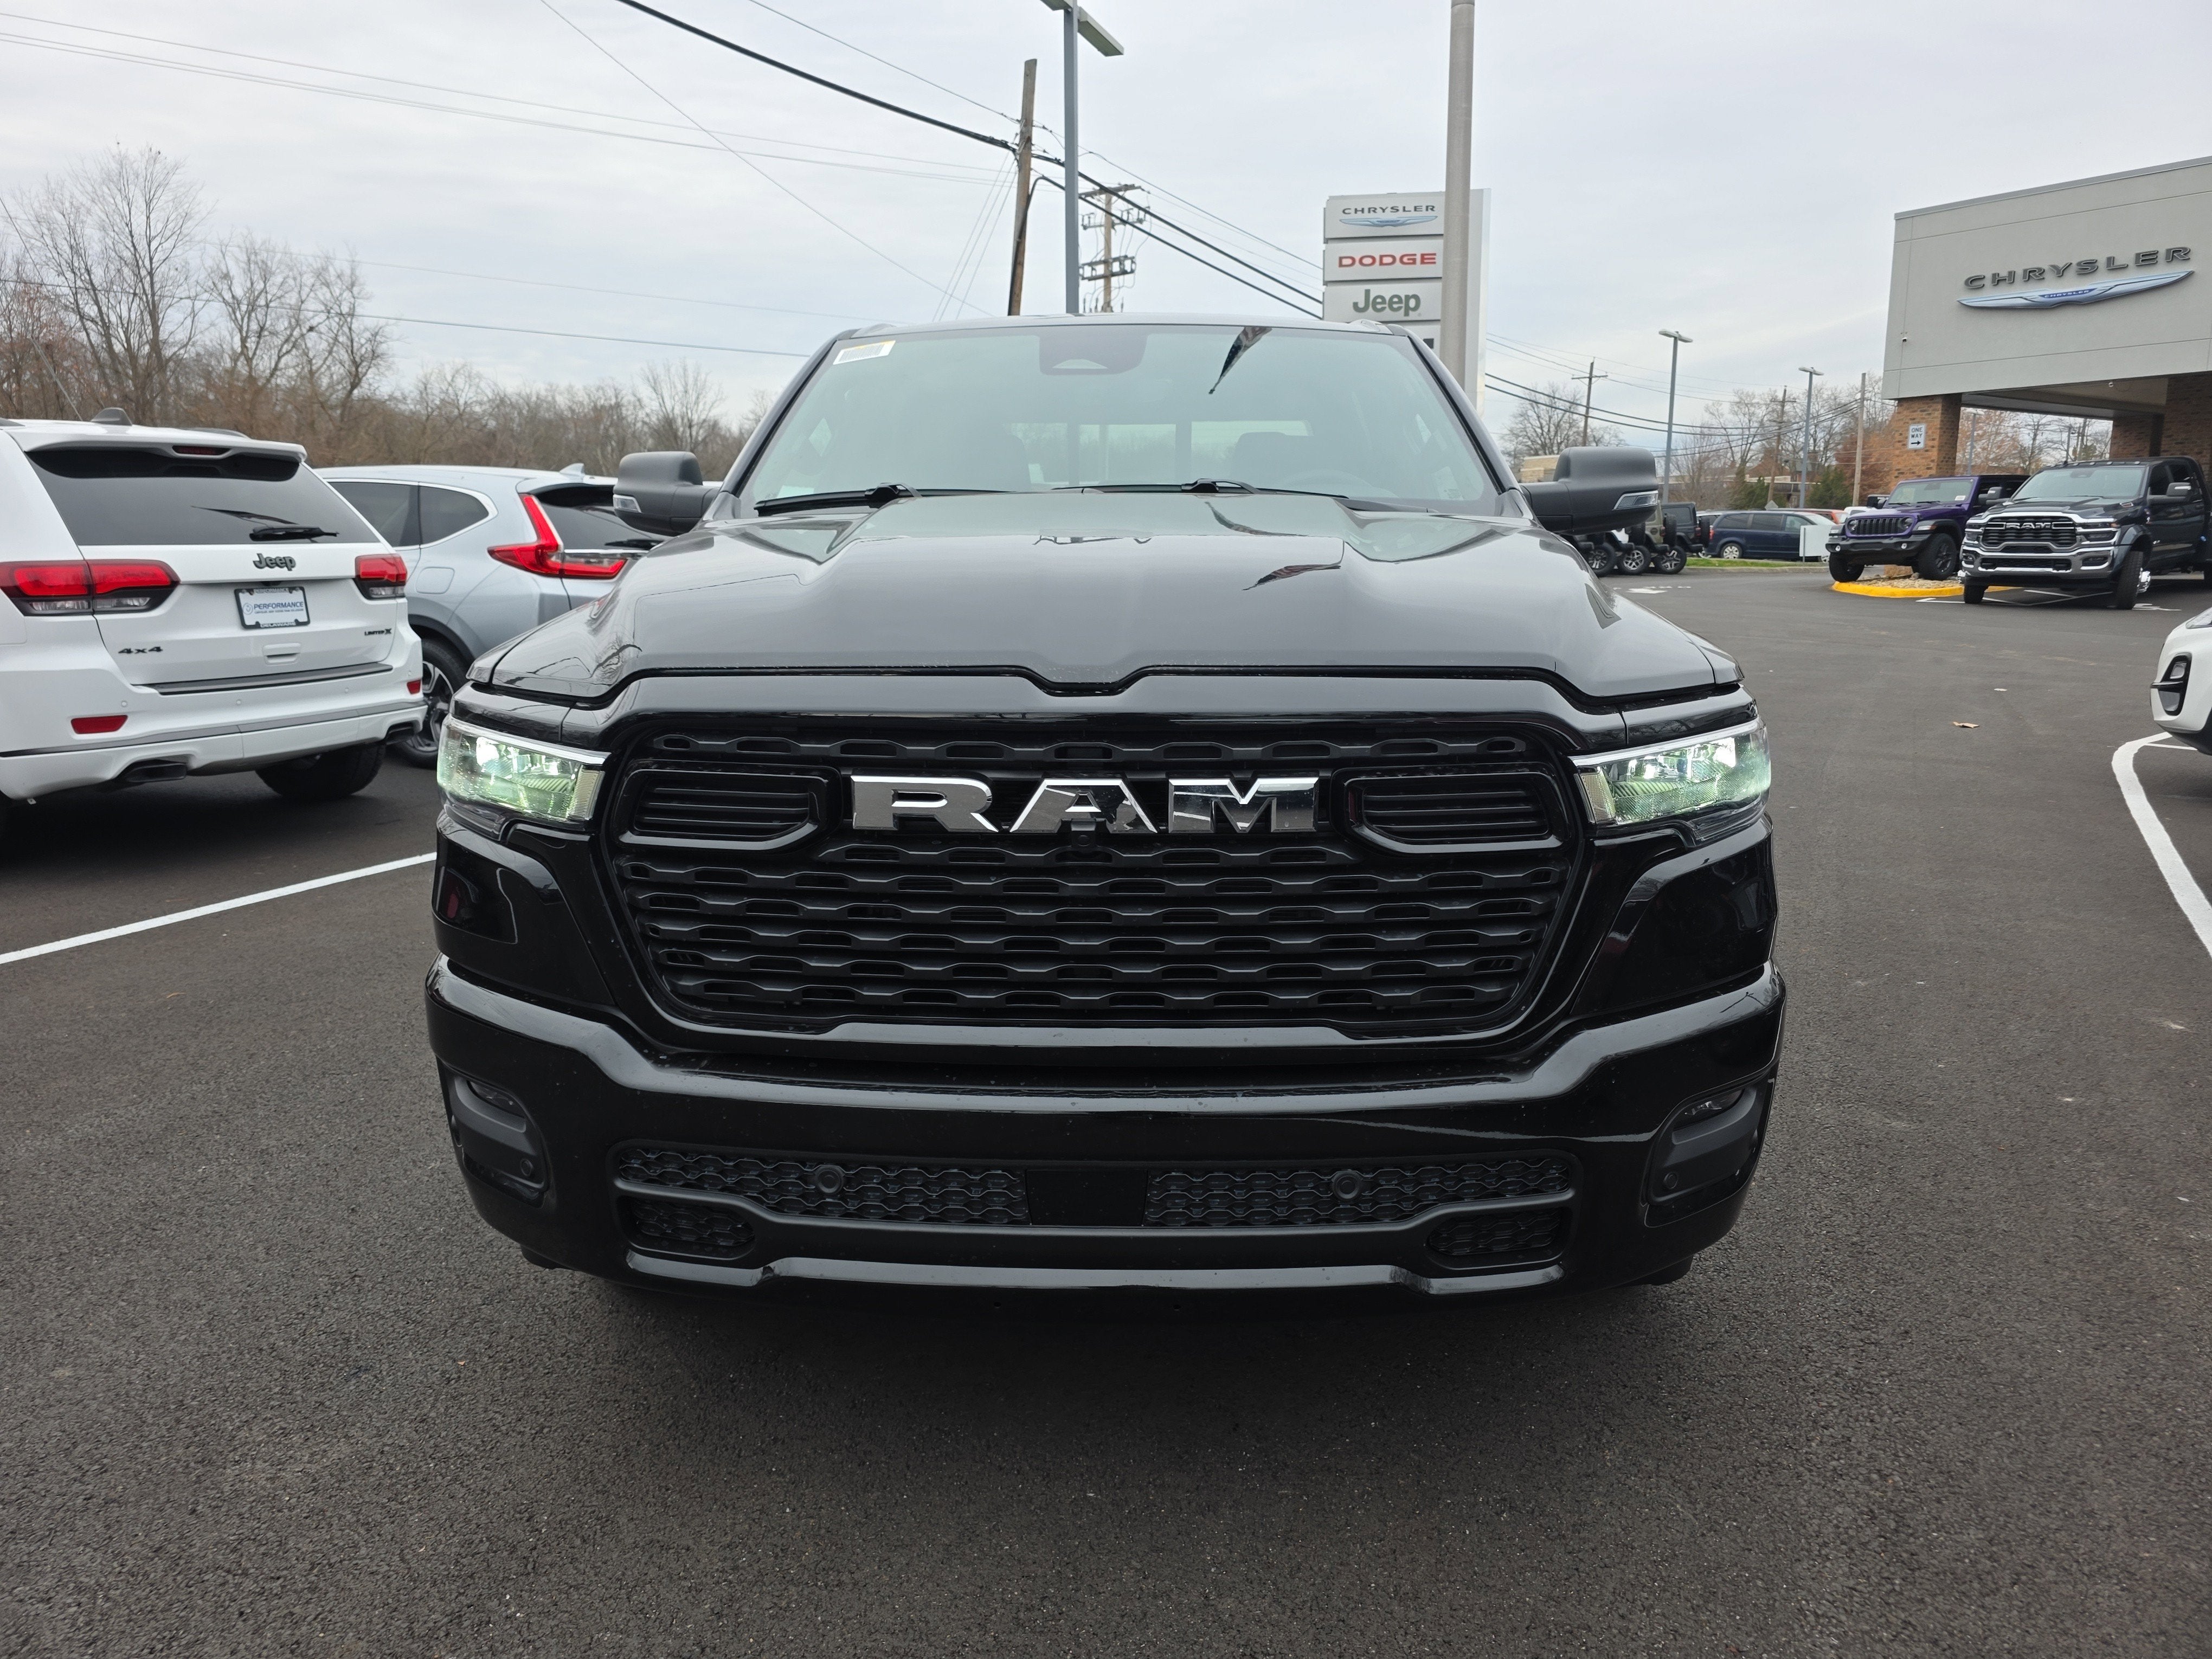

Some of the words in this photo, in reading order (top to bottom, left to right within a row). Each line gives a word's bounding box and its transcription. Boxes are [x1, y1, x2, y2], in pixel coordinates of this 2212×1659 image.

[1342, 205, 1436, 215] CHRYSLER
[1338, 253, 1436, 268] DODGE
[1963, 246, 2191, 290] CHRYSLER
[1352, 288, 1421, 317] Jeep
[2044, 290, 2089, 299] CHRYSLER
[253, 553, 297, 571] Jeep
[254, 601, 304, 609] PERFORMANCE
[851, 774, 1319, 833] RAM
